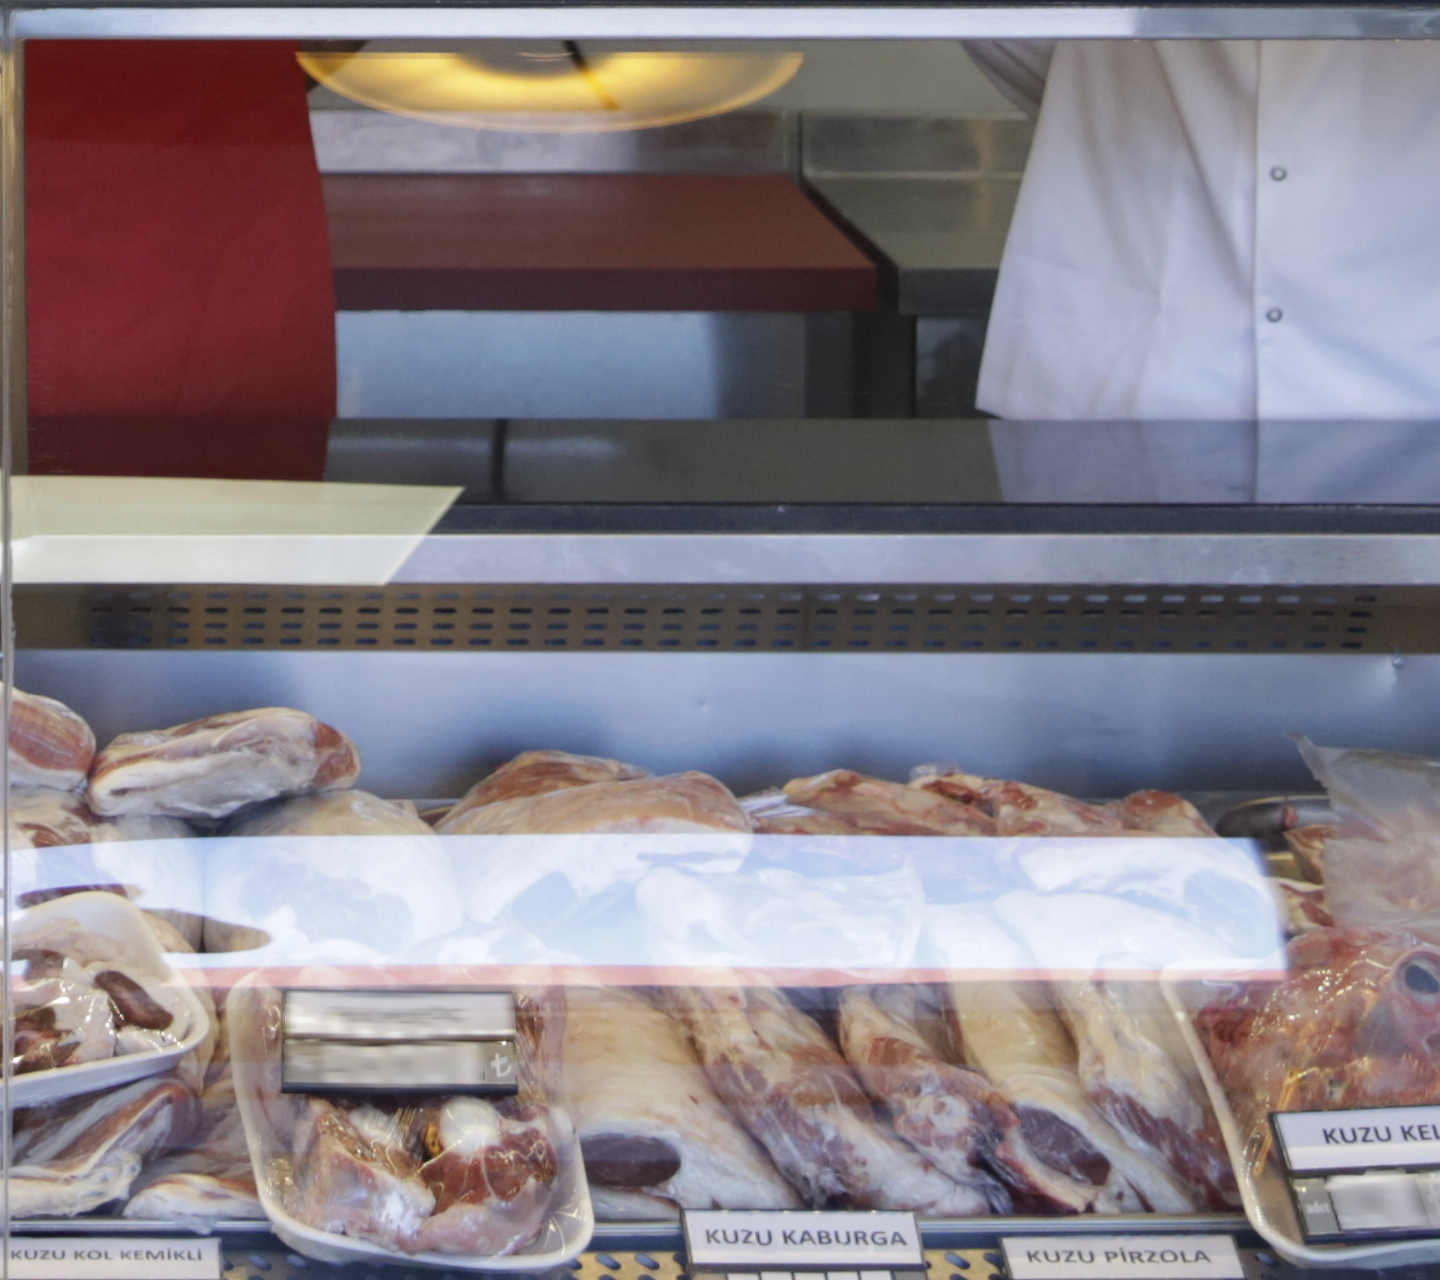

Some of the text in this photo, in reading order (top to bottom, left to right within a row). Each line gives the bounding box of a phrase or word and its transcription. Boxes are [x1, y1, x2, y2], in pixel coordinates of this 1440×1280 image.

[1322, 1126, 1392, 1145] KUZU
[704, 1228, 908, 1246] KUZU KABURGA
[10, 1246, 203, 1262] KUZU KOL KEMİKLİ
[1025, 1246, 1212, 1264] KUZU PİRZOLA
